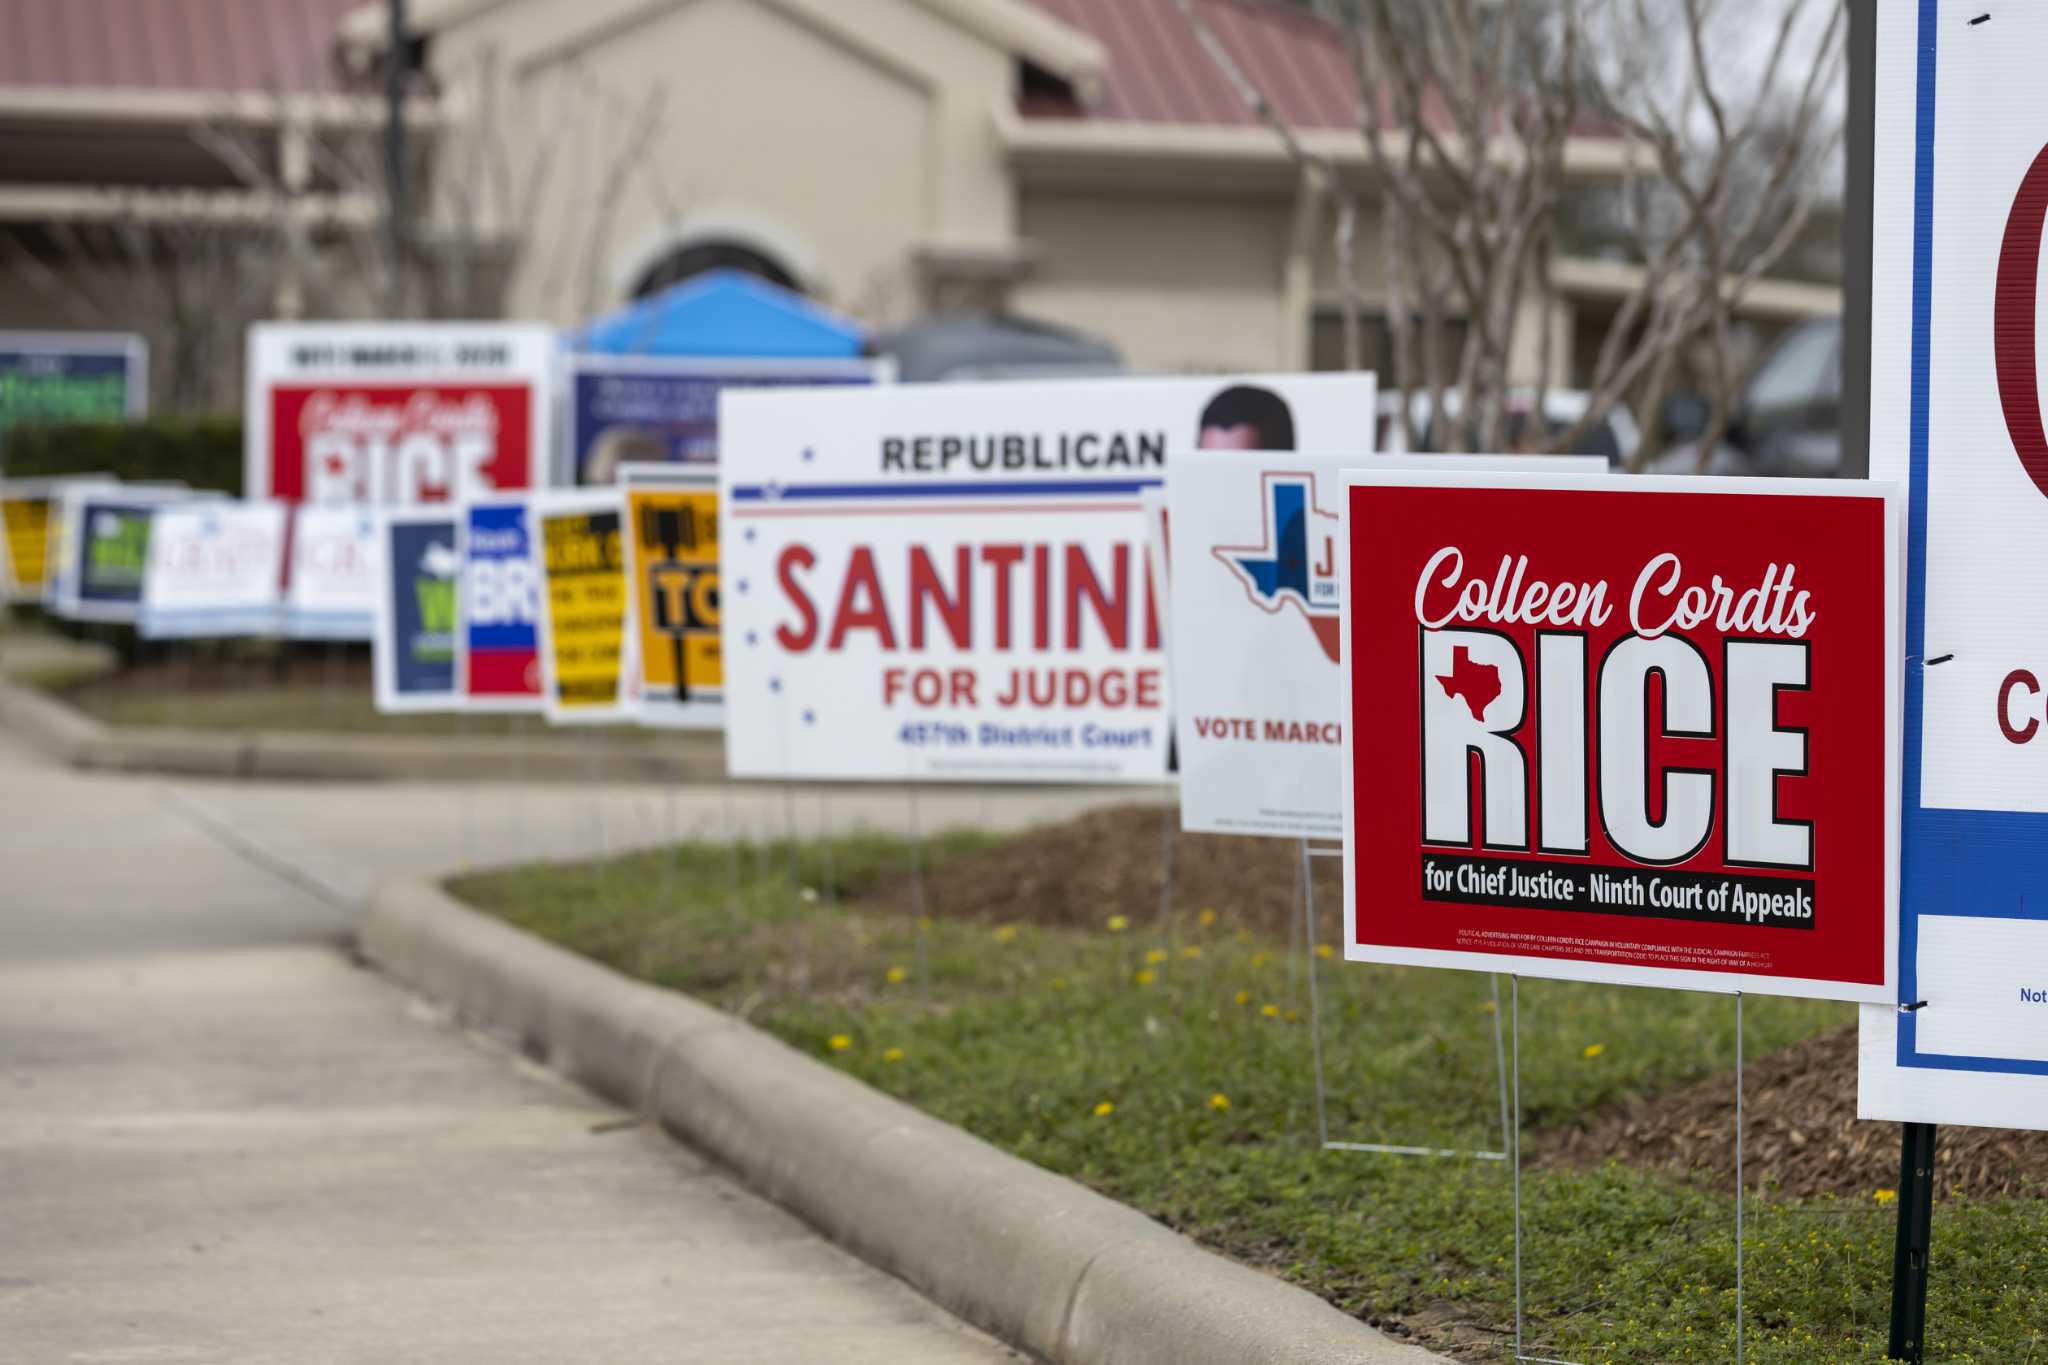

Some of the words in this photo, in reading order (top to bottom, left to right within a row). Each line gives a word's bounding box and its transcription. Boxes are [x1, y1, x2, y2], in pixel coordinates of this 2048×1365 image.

[880, 432, 1166, 473] REPUBLICAN
[1414, 546, 1613, 629] Colleen
[1629, 552, 1816, 640] Cordts
[882, 668, 978, 709] FOR
[995, 668, 1162, 709] JUDGE
[978, 722, 1074, 747] District
[1081, 724, 1153, 747] Court
[1195, 716, 1257, 741] VOTE
[1420, 628, 1815, 871] RICE
[1425, 861, 1453, 892] for
[1457, 864, 1507, 896] Chief
[1509, 868, 1574, 900] Justice
[1590, 873, 1644, 906] Ninth
[1650, 877, 1703, 911] Court
[1707, 881, 1729, 912] of
[1732, 883, 1812, 923] Appeals
[2020, 988, 2047, 1003] Not
